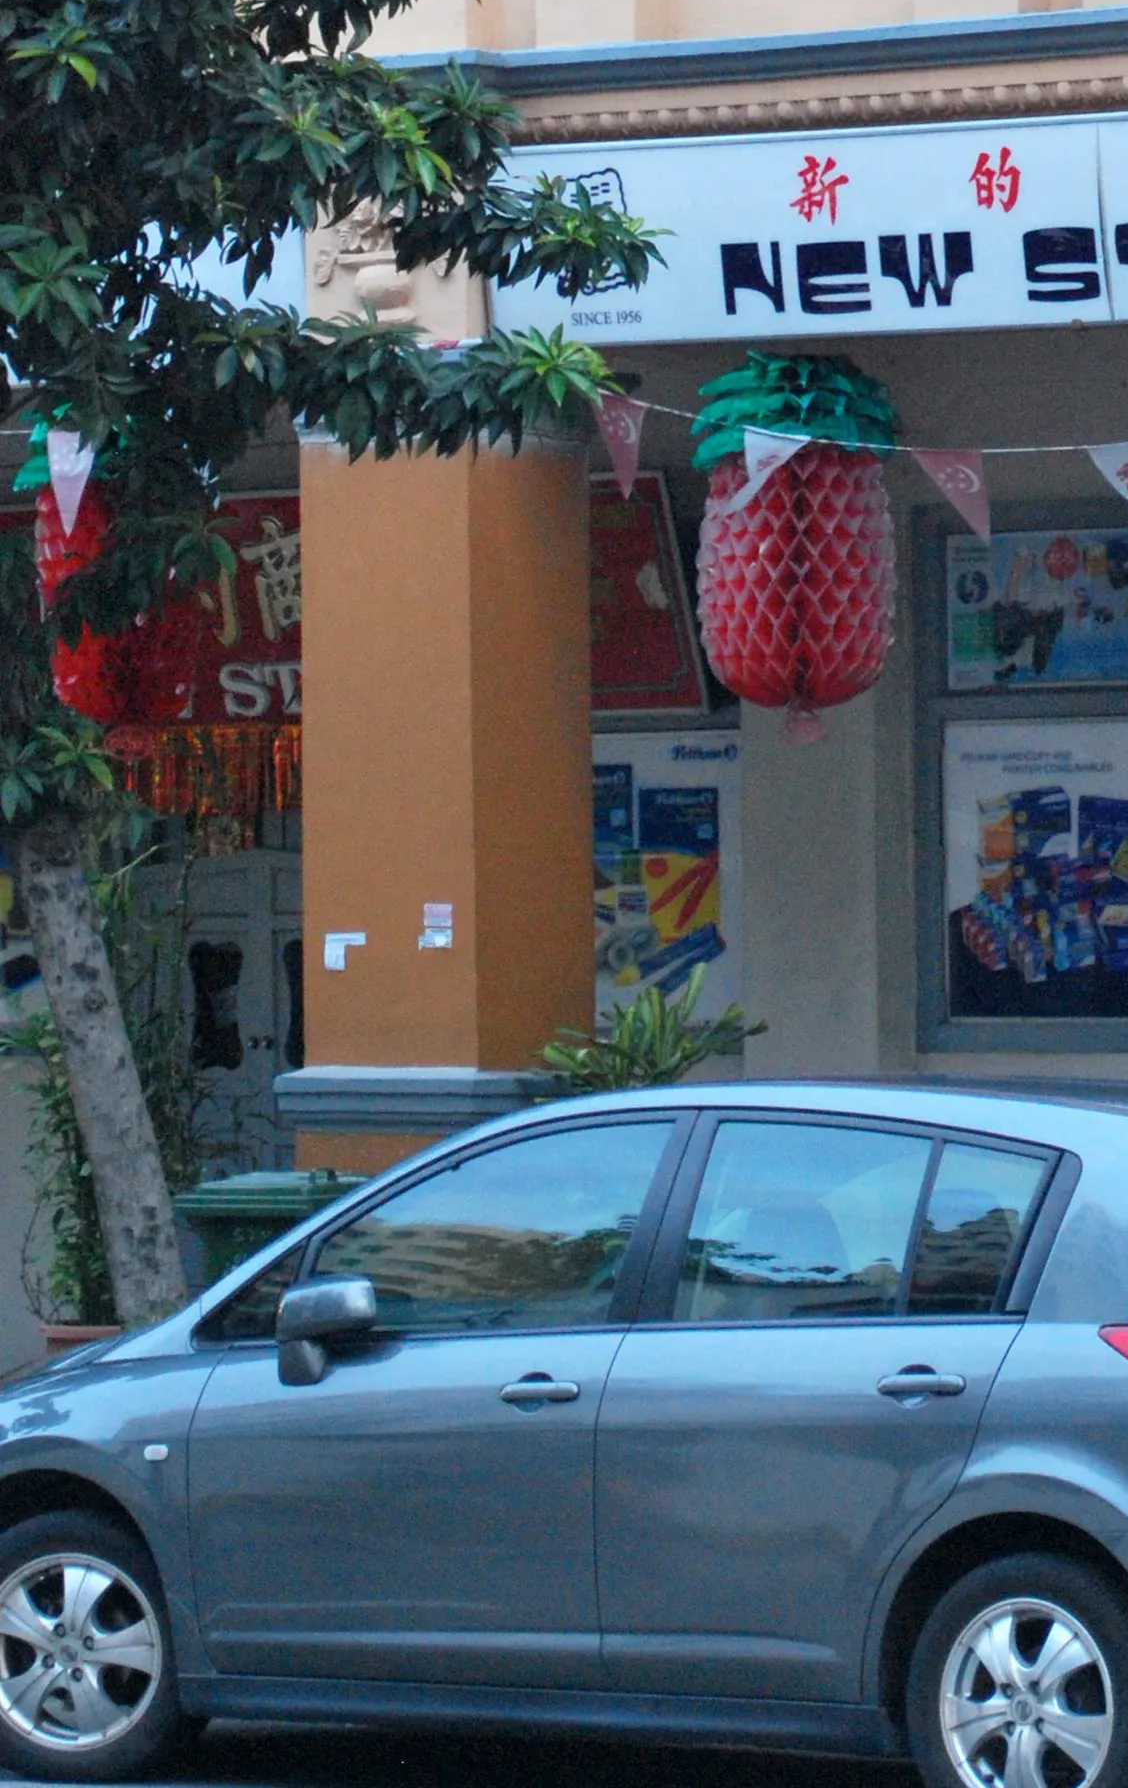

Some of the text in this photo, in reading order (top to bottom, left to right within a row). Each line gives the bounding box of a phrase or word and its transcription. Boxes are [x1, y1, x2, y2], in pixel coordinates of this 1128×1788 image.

[719, 229, 974, 317] NEW
[570, 310, 643, 327] SINCE 1956
